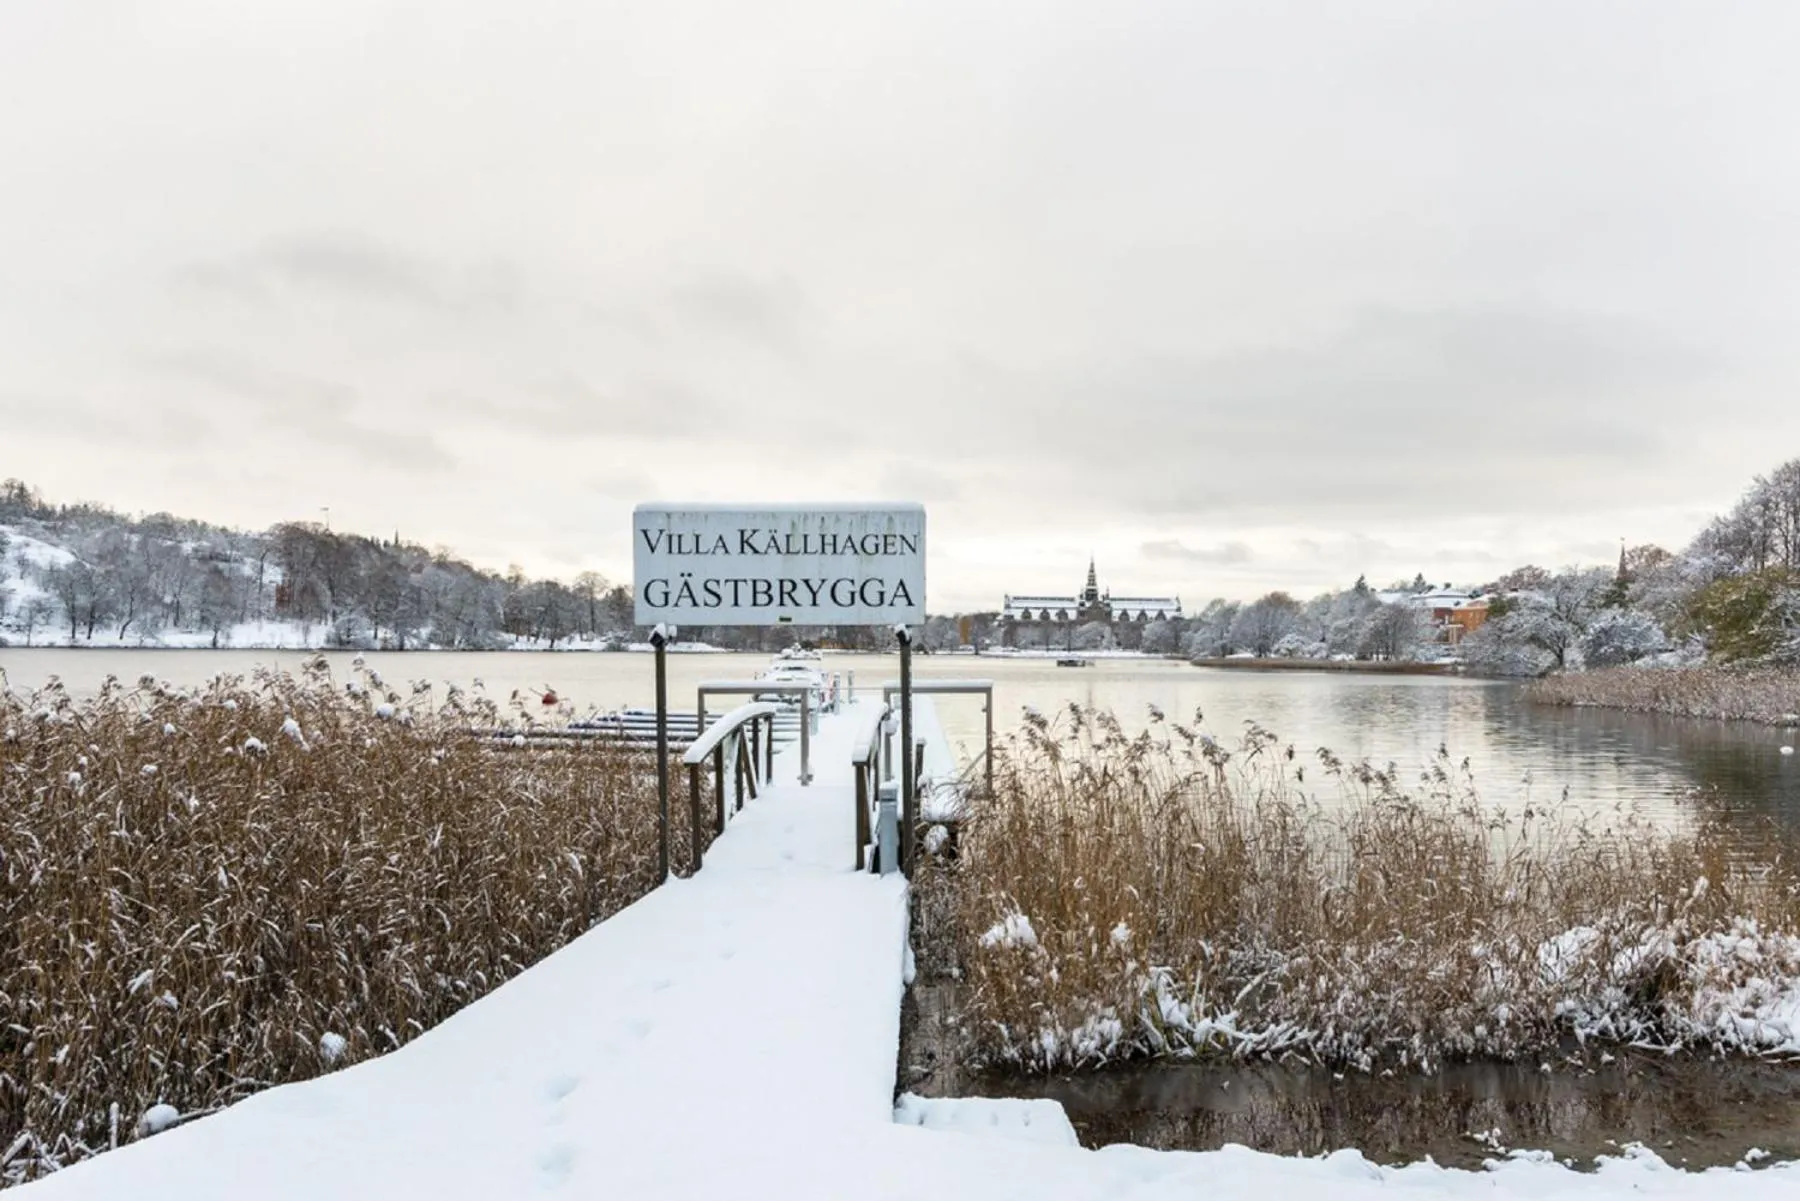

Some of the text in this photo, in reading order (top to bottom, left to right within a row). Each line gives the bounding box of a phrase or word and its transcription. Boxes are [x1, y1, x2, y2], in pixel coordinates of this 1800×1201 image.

[640, 528, 918, 556] VILLA KÄLLHAGEN
[643, 572, 916, 608] GÄSTBRYGGA
